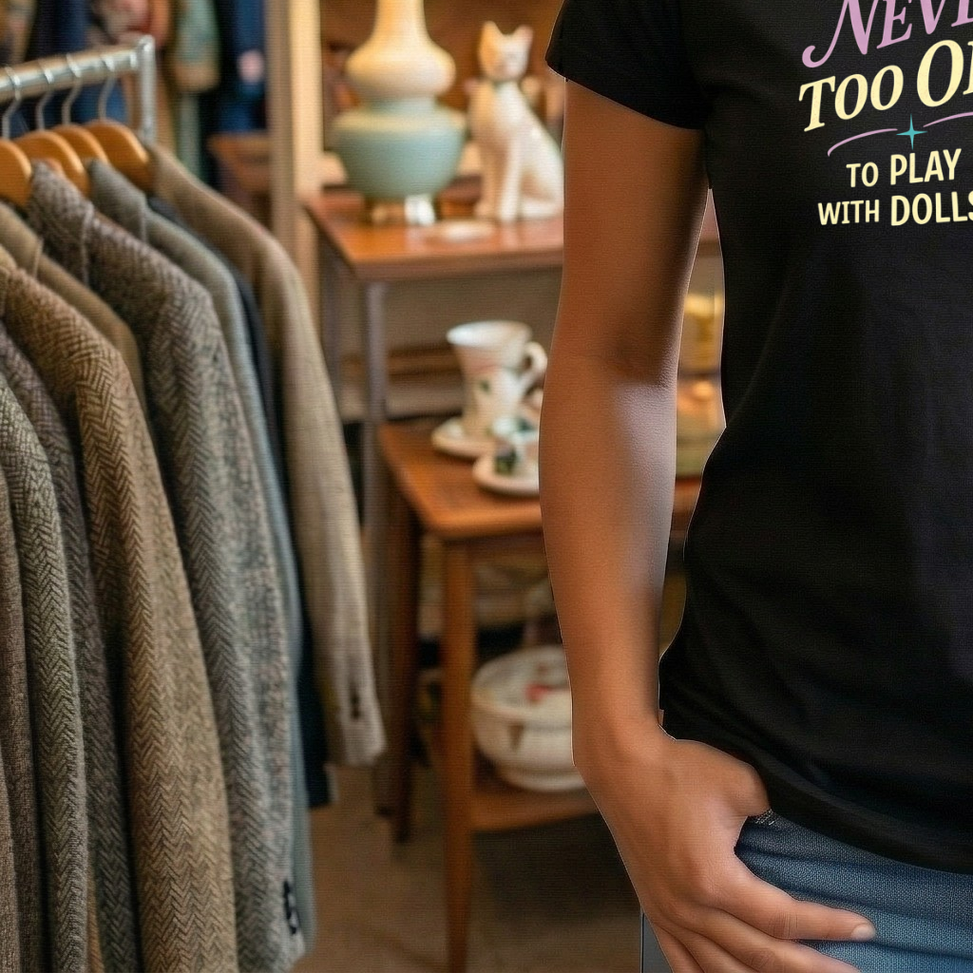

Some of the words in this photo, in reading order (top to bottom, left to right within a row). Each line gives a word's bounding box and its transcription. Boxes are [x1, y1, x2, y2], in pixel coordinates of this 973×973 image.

[798, 64, 905, 132] TOO
[845, 162, 880, 188] TO
[889, 148, 963, 186] PLAY
[817, 199, 881, 226] WITH
